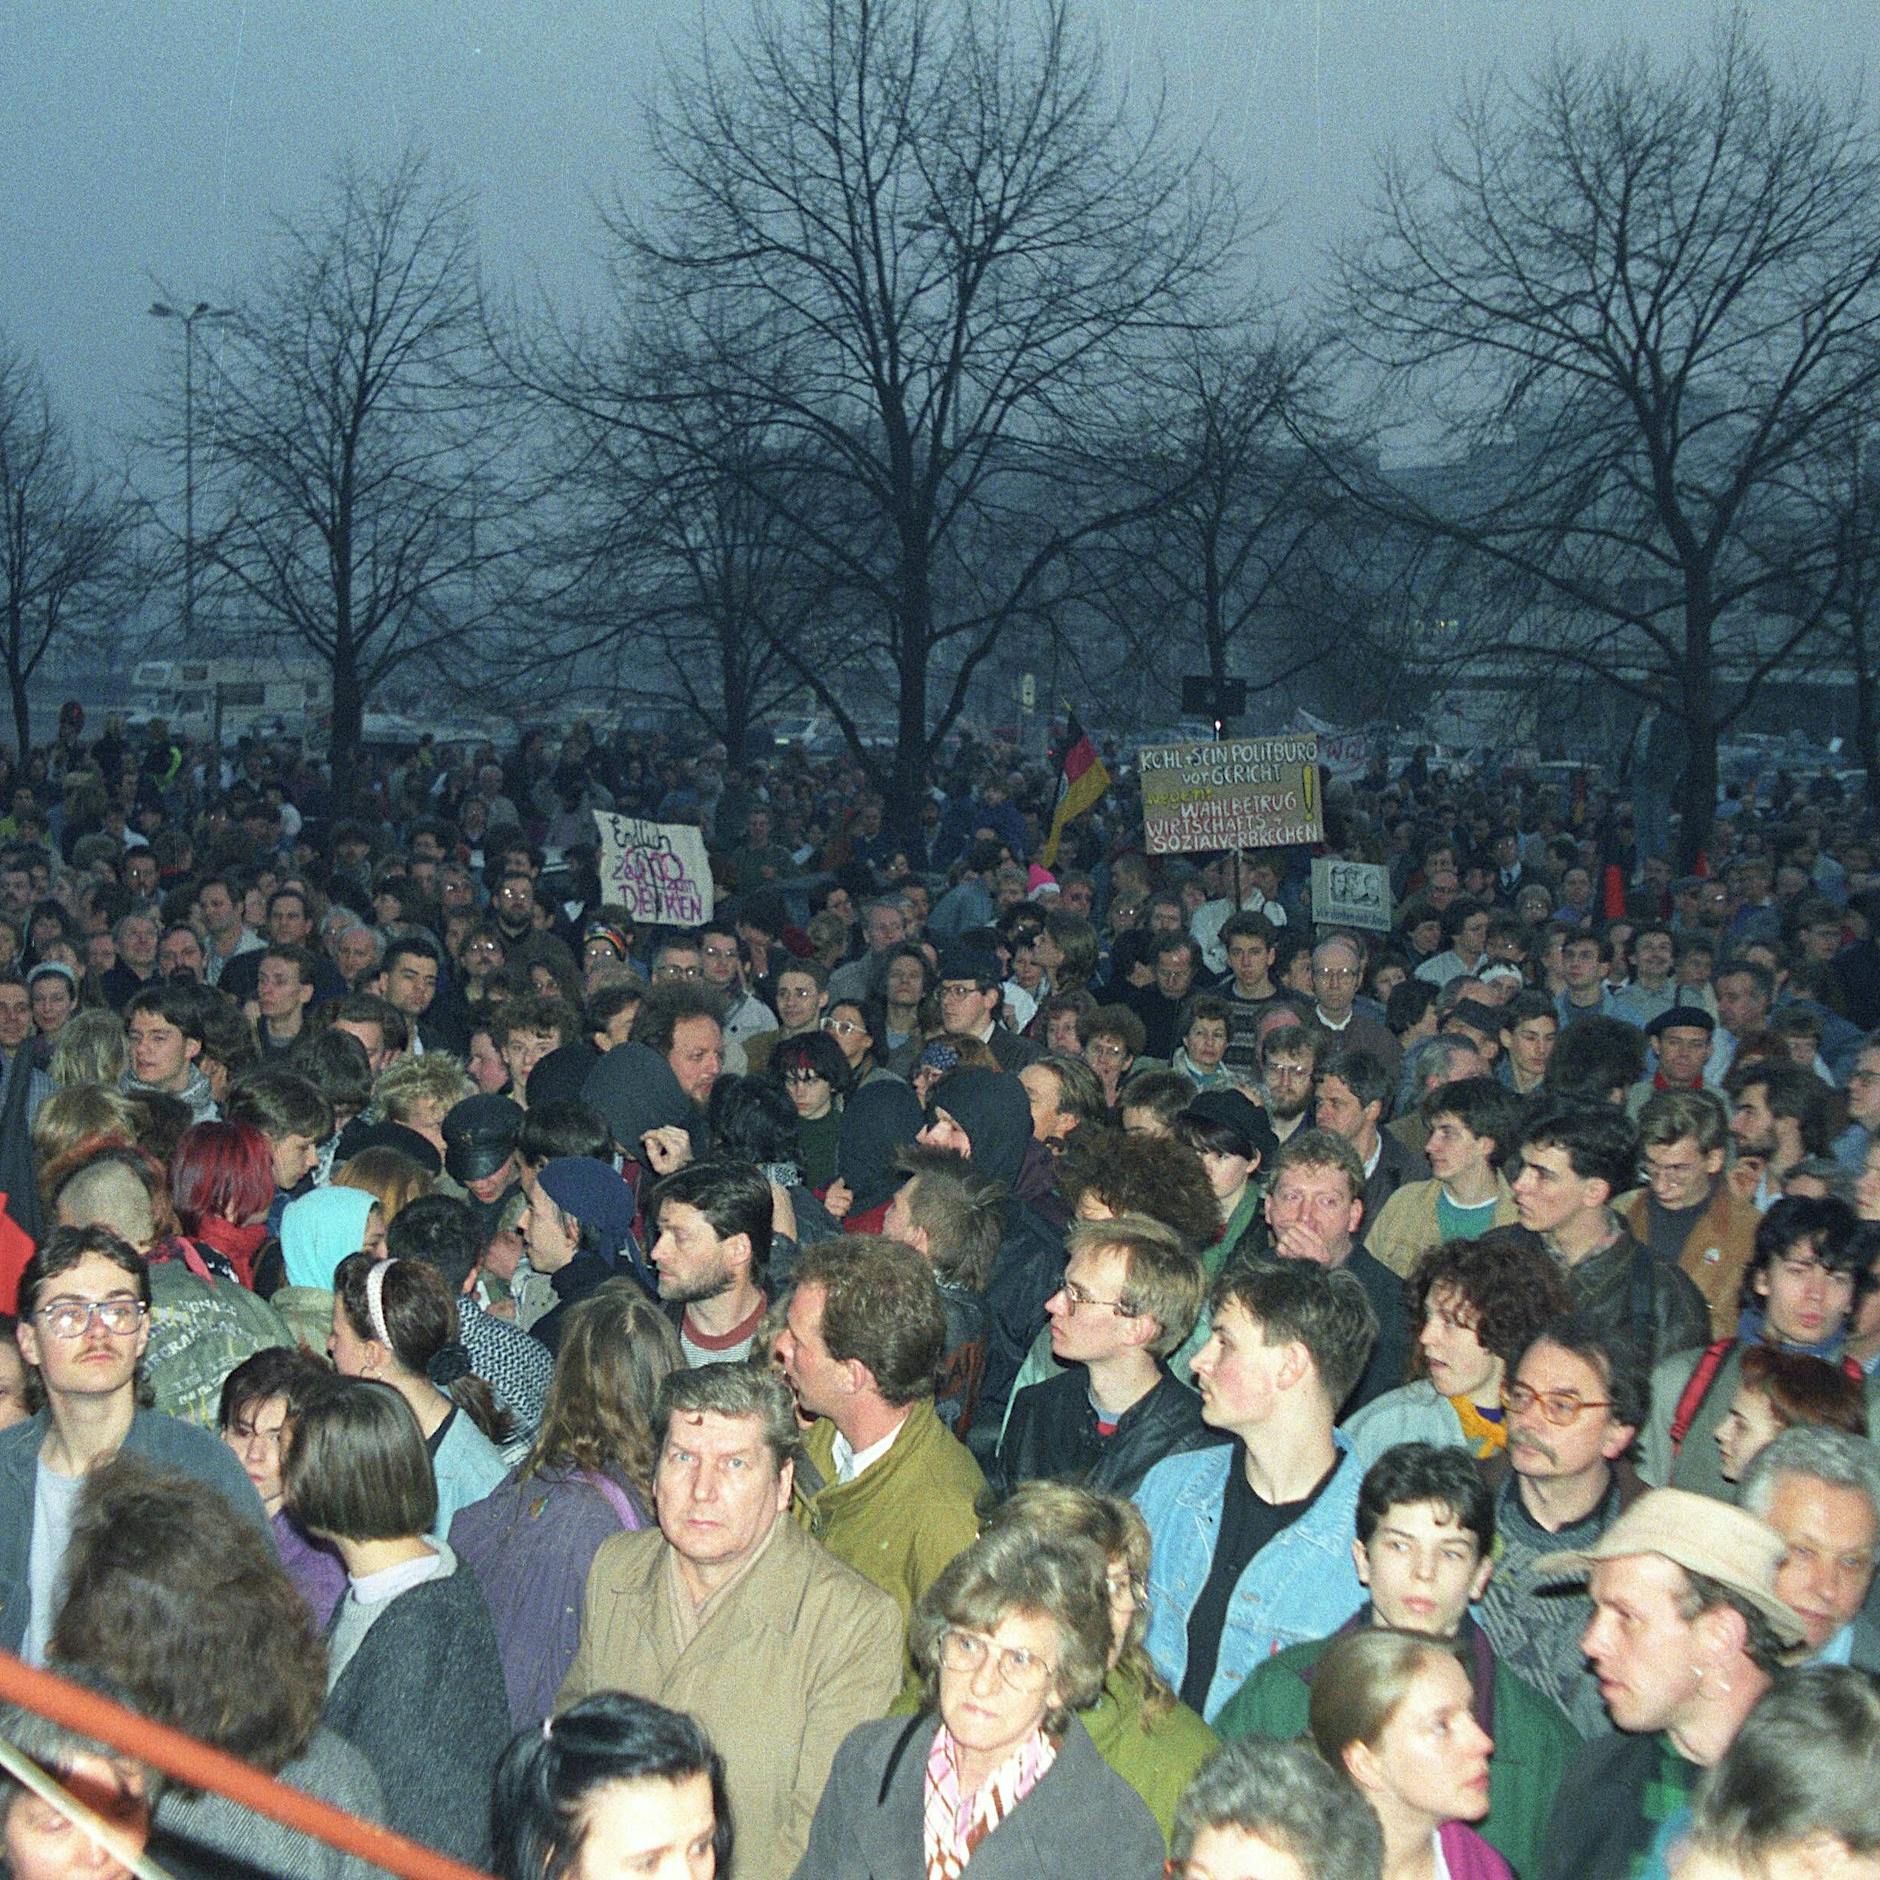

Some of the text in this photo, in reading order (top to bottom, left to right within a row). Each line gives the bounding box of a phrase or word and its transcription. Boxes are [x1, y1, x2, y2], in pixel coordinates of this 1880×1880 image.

[1232, 736, 1317, 762] POLITBÜRO
[1212, 763, 1282, 785] GERICHT
[1181, 791, 1297, 817] WAHLBETRUG
[1152, 824, 1318, 853] SOZIALVERBRECHEN
